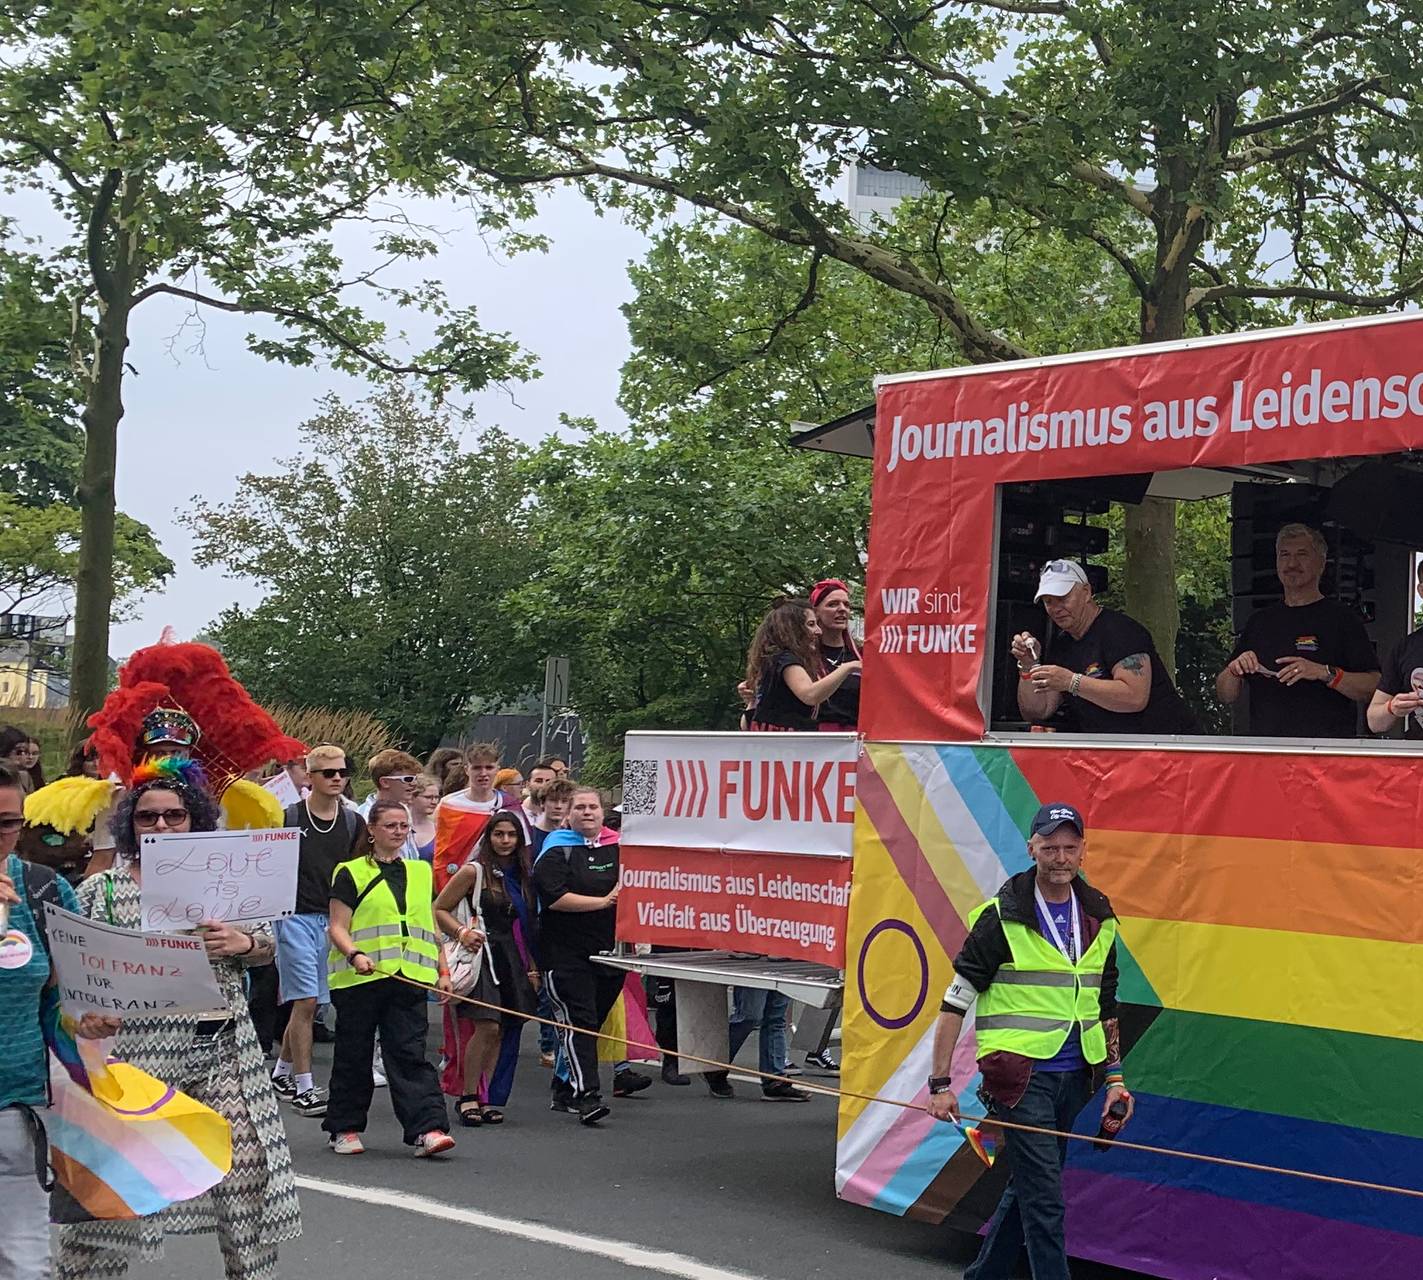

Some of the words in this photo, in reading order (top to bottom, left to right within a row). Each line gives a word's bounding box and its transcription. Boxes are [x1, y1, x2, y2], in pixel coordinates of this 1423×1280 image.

[886, 401, 1133, 472] Journalismus
[1142, 394, 1220, 441] aus
[881, 587, 920, 615] WIR
[924, 585, 961, 614] sind
[906, 624, 977, 654] FUNKE
[719, 760, 857, 824] FUNKE
[264, 831, 297, 842] FUNKE
[618, 863, 721, 894] Journalismus
[725, 874, 755, 897] aus
[636, 901, 696, 930] Vielfalt
[700, 910, 730, 932] aus
[50, 928, 88, 948] KEINE
[161, 938, 201, 951] FUNKE
